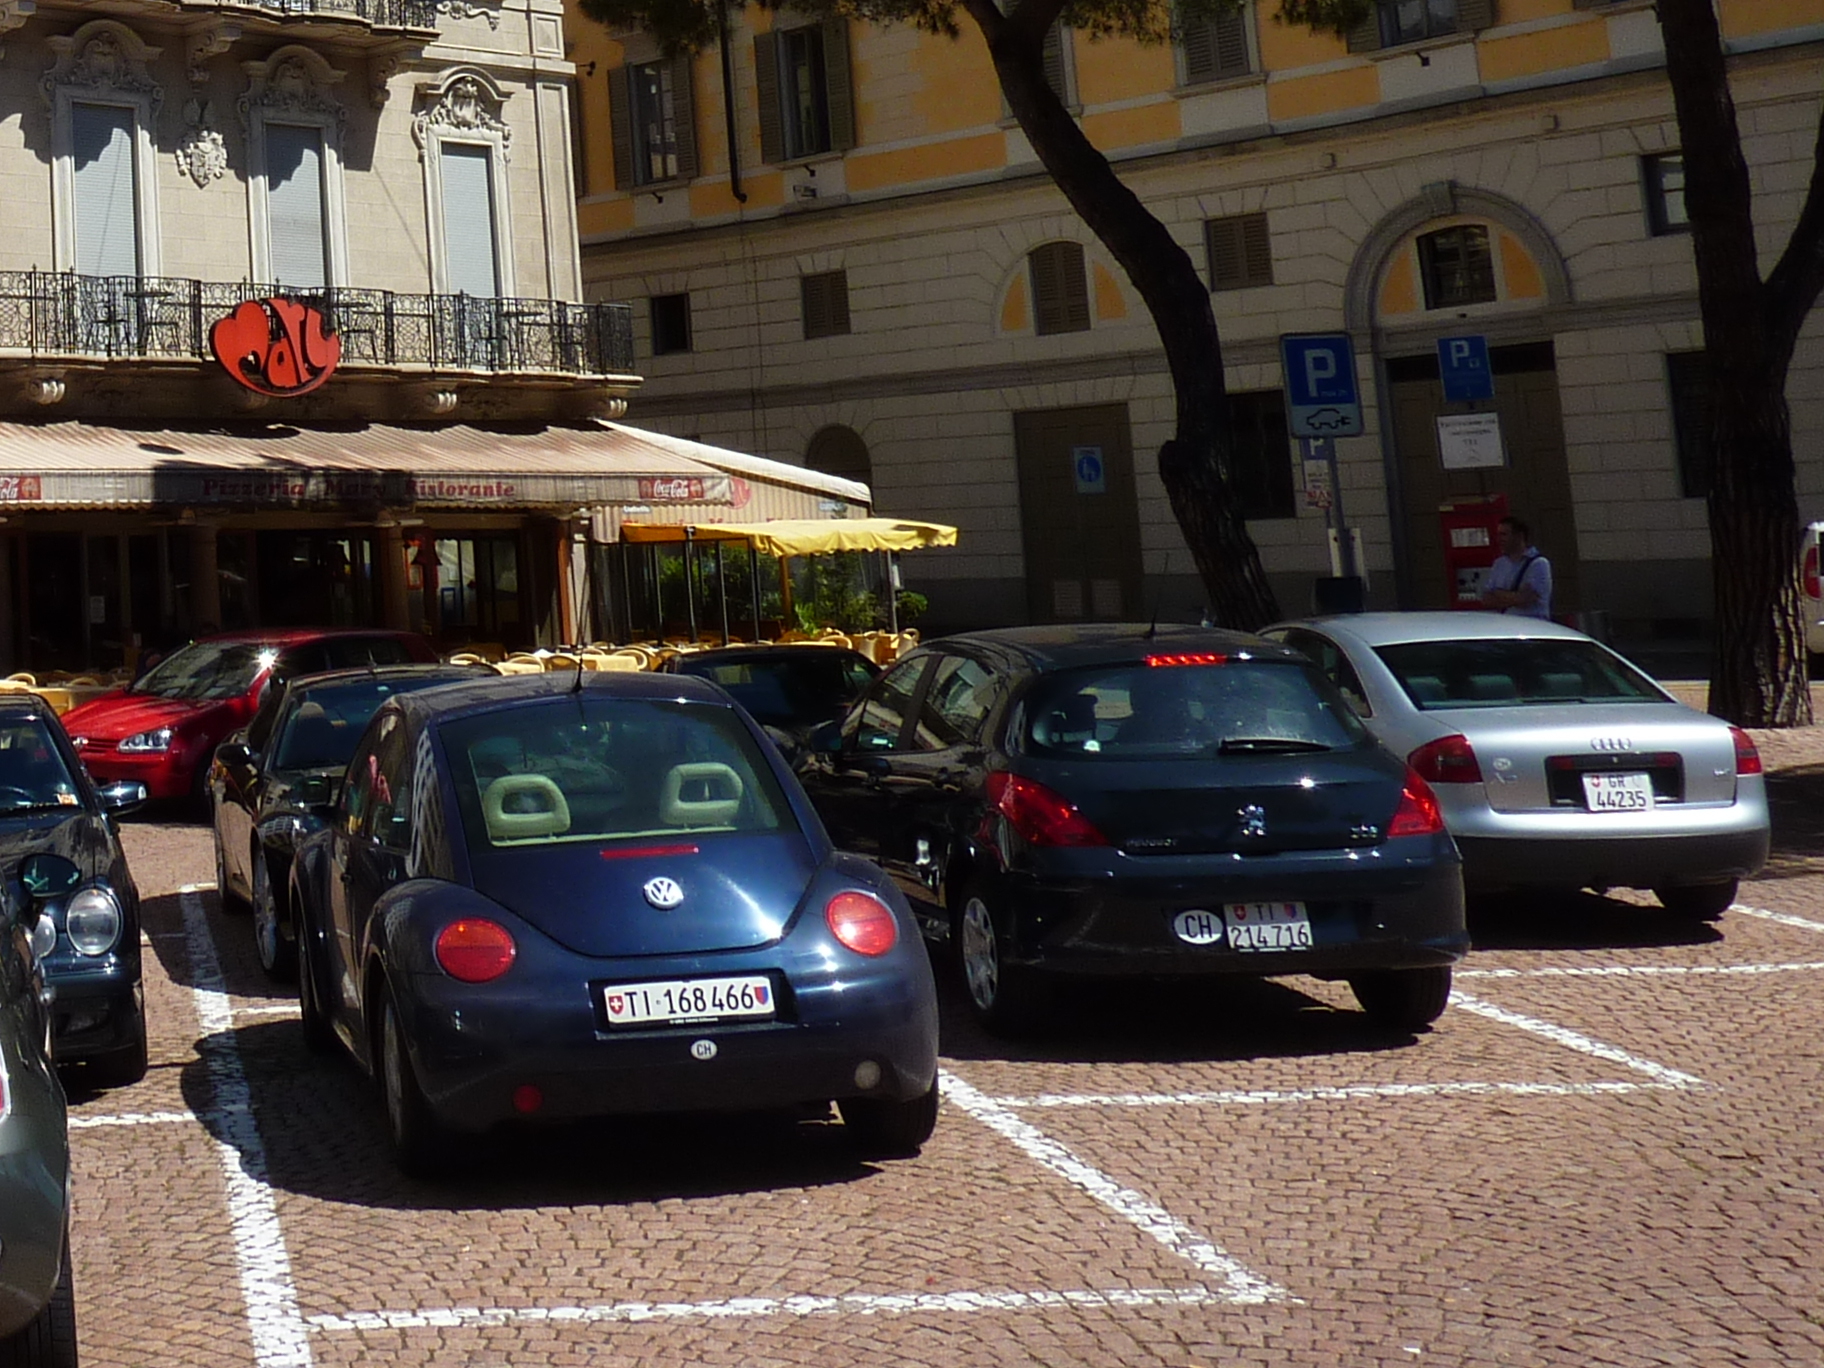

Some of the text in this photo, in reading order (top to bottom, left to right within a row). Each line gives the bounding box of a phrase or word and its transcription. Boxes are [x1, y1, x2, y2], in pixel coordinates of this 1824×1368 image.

[1449, 340, 1470, 368] P
[1303, 348, 1337, 398] P
[204, 481, 305, 497] Pizzeria
[406, 481, 515, 497] Ristorante
[1609, 776, 1626, 788] GR
[1597, 791, 1647, 808] 44235
[1254, 904, 1275, 921] TI
[1184, 914, 1212, 939] CH
[1230, 923, 1309, 948] 214716
[696, 1043, 713, 1056] CH
